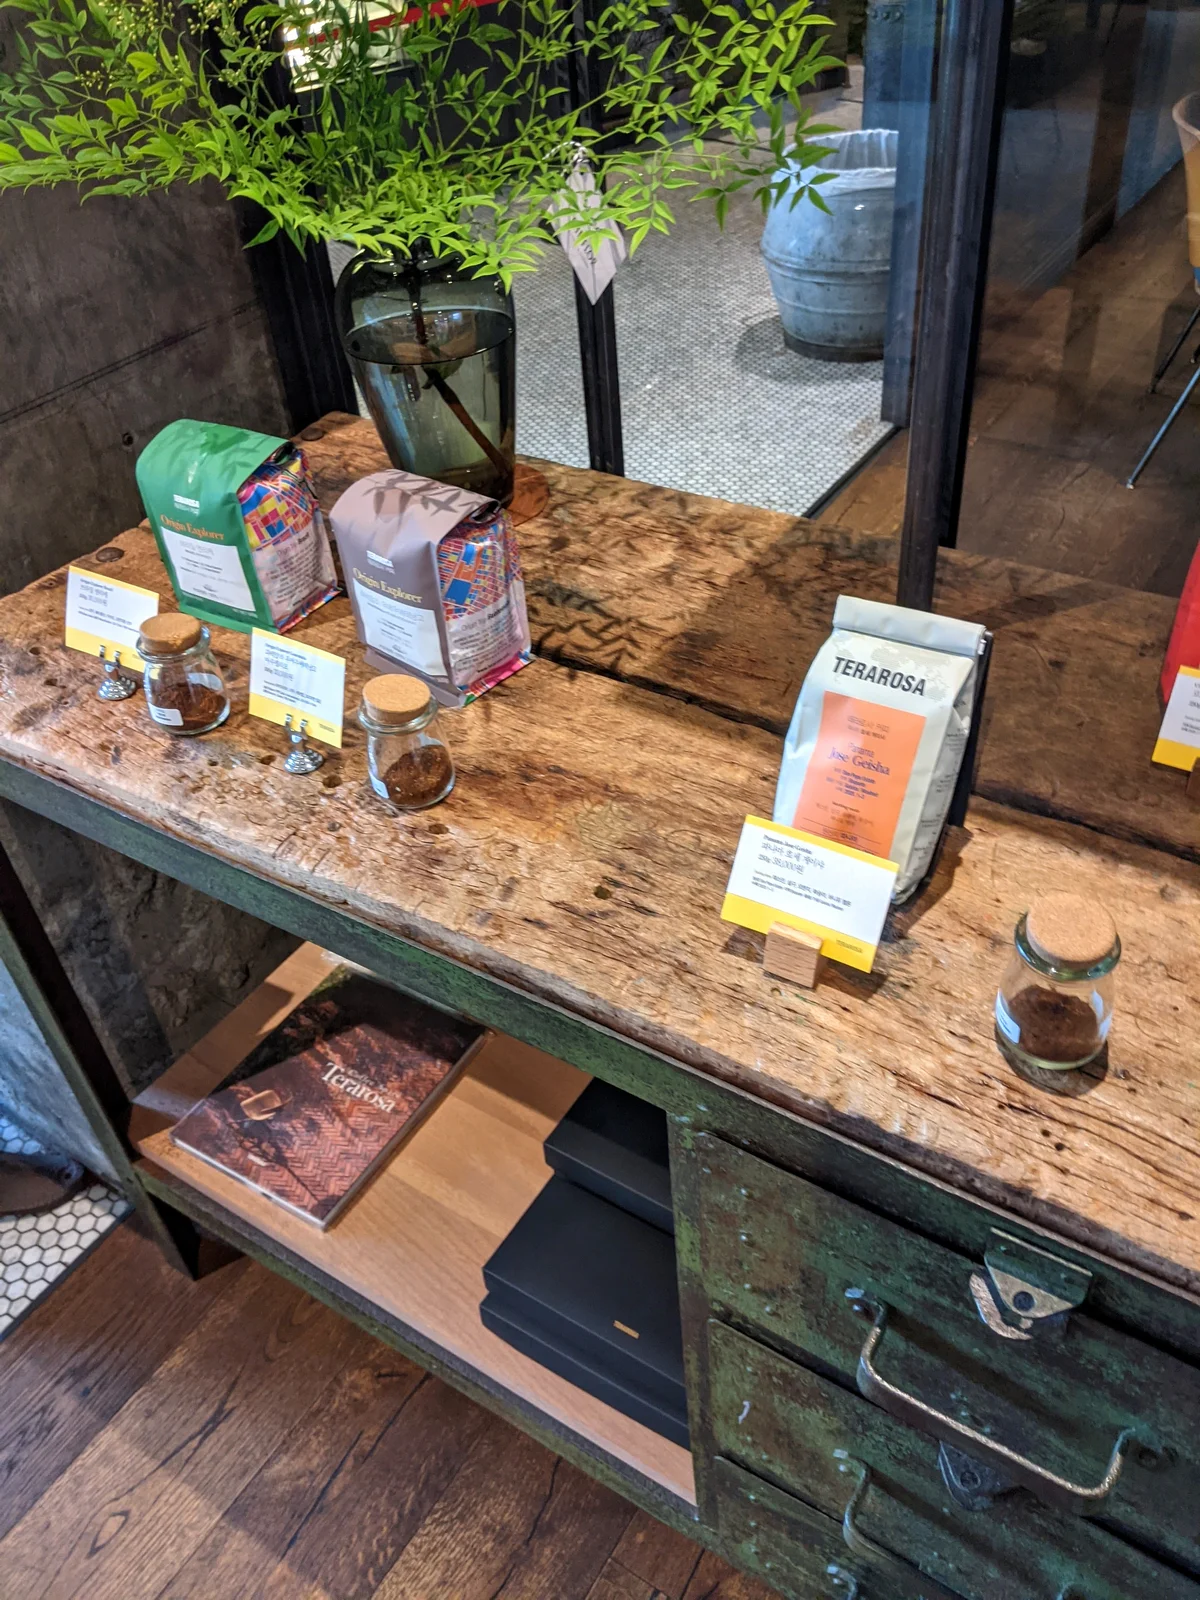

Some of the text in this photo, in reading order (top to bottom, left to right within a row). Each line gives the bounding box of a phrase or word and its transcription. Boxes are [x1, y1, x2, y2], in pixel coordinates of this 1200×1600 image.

[161, 514, 224, 541] Origin Explorer
[353, 567, 423, 604] Origin Explorer
[832, 656, 927, 697] TERAROSA
[827, 747, 849, 764] Jose
[852, 754, 890, 776] Geisha
[321, 1062, 396, 1113] Terarosa
